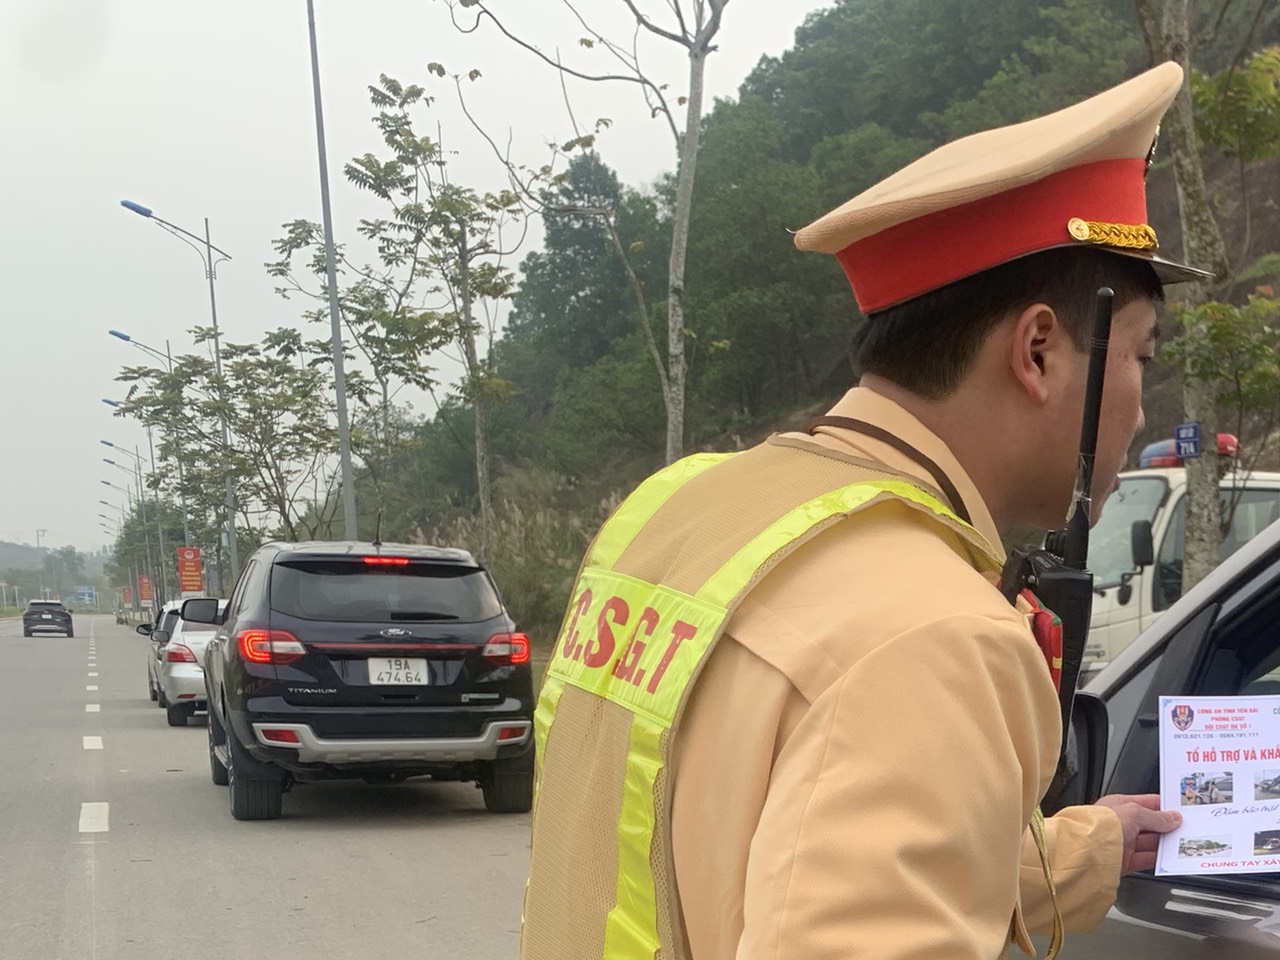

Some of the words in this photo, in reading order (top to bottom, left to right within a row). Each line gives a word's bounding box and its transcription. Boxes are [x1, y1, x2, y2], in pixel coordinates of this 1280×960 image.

[563, 588, 698, 694] C.S.G.T
[387, 658, 410, 671] 19A
[377, 672, 421, 684] 474.64
[1186, 746, 1200, 763] TỔ
[1220, 749, 1241, 764] TRỢ
[1243, 747, 1257, 761] VÀ
